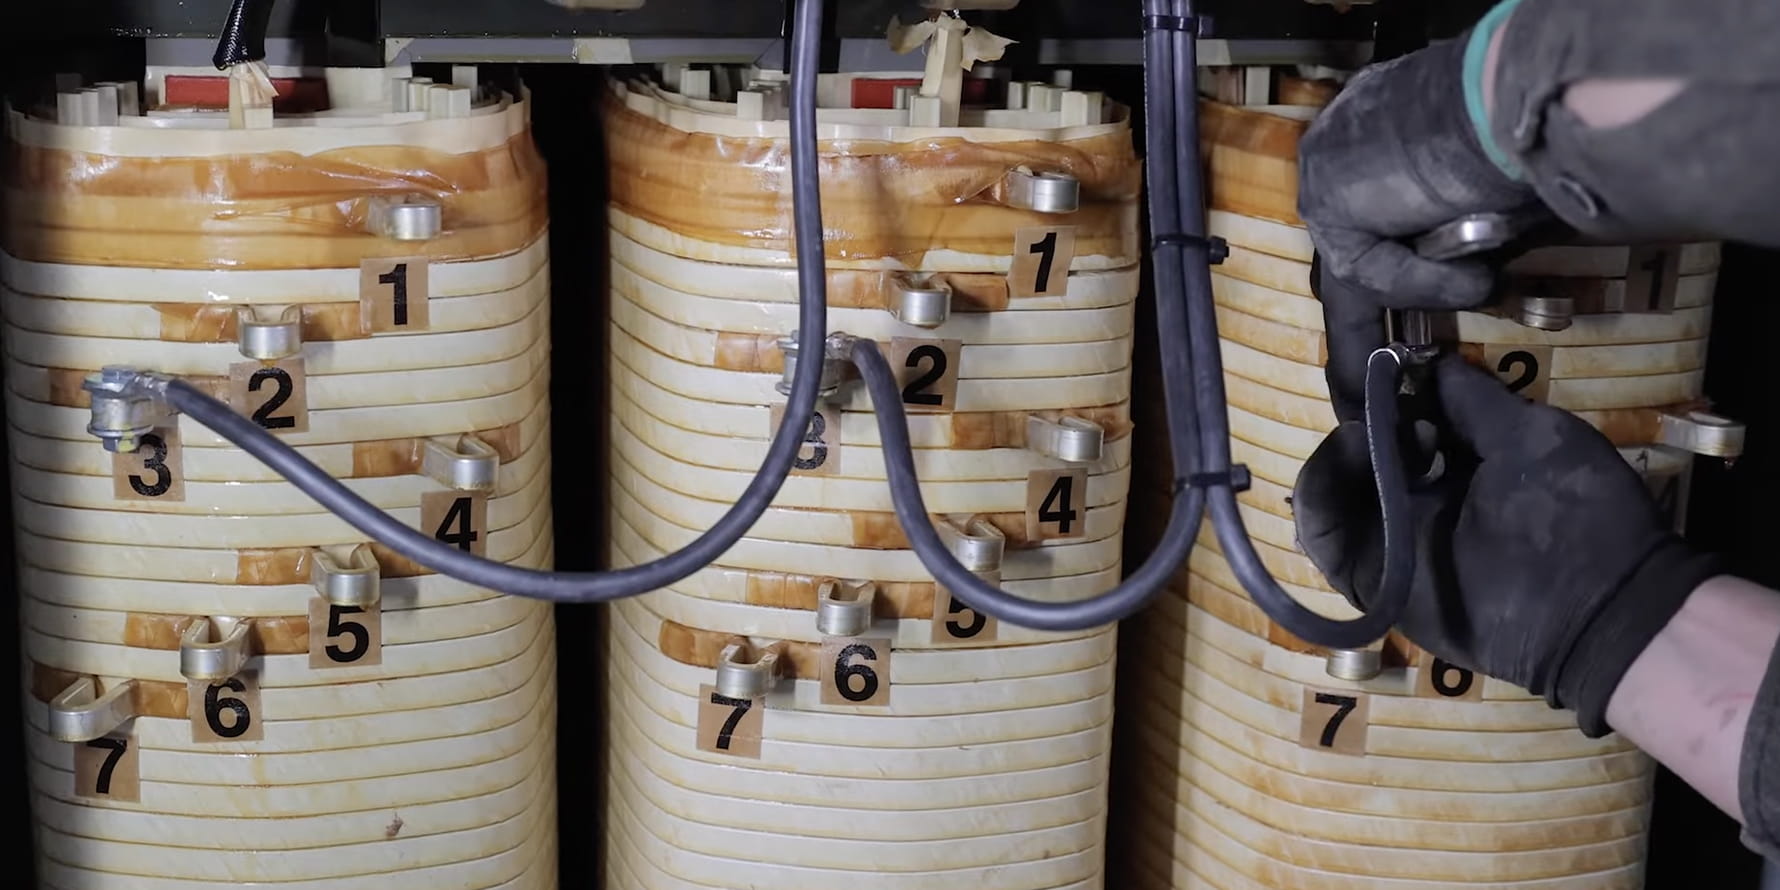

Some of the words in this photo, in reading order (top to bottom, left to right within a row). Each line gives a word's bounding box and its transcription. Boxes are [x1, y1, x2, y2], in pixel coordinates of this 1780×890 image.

[1028, 232, 1057, 293] 1
[1639, 250, 1664, 311] 1
[379, 264, 409, 325] 1
[248, 367, 295, 429] 2
[903, 345, 947, 405] 2
[1497, 351, 1539, 397] 2
[128, 434, 173, 496] 3
[435, 497, 478, 553] 4
[1037, 476, 1077, 535] 4
[325, 603, 369, 664] 5
[945, 599, 987, 639] 5
[834, 644, 878, 702] 6
[205, 678, 250, 739] 6
[711, 693, 752, 751] 7
[1314, 693, 1358, 748] 7
[87, 739, 128, 795] 7
